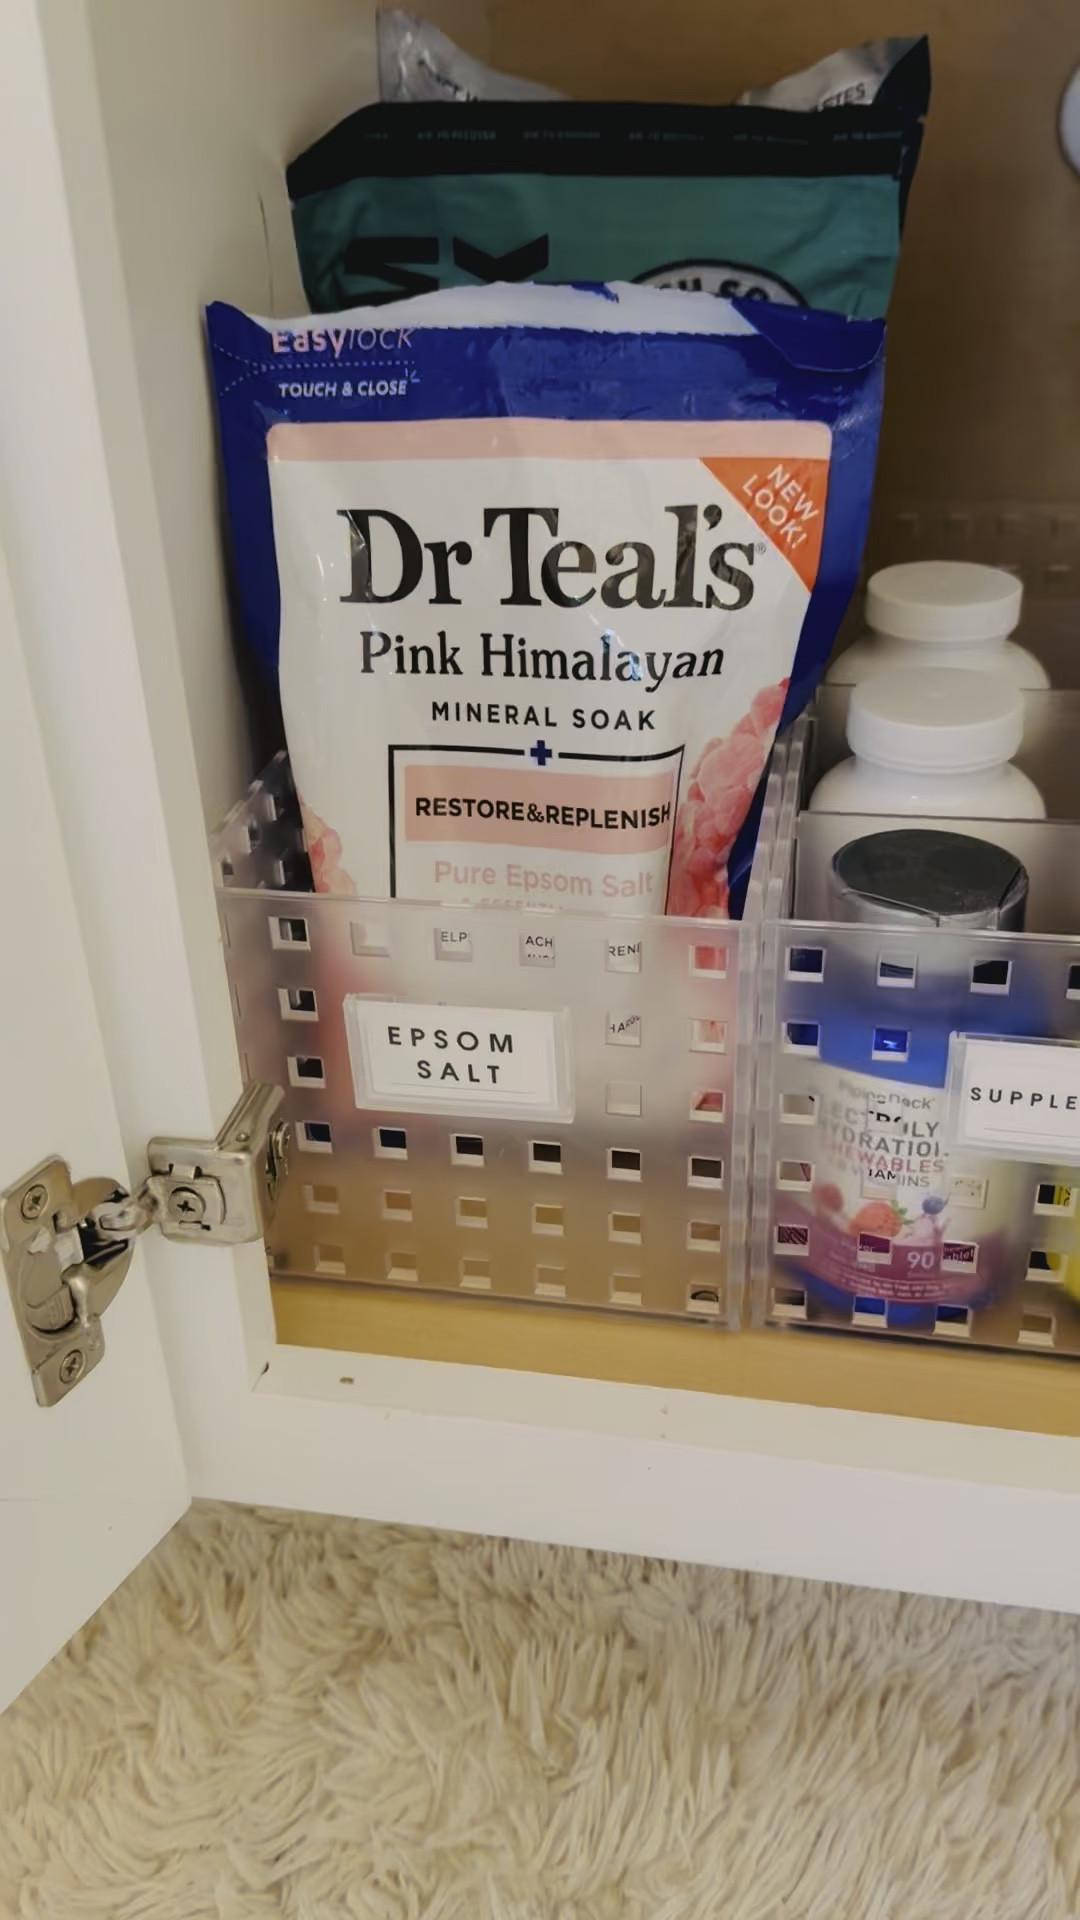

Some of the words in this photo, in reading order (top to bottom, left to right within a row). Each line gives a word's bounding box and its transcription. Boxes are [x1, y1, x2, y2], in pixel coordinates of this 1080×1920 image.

[279, 382, 337, 398] TOUCH
[342, 382, 353, 397] &
[358, 380, 407, 396] CLOSE
[767, 463, 819, 521] NEW
[742, 473, 807, 549] LOOK!
[336, 509, 472, 605] Dr
[483, 504, 755, 611] Teal's
[360, 630, 463, 676] Pink
[480, 630, 724, 693] Himalayan
[432, 701, 557, 727] MINERAL
[572, 708, 656, 731] SOAK
[434, 860, 497, 885] Pure
[506, 864, 592, 896] Epsom
[602, 872, 653, 897] Salt
[387, 1026, 513, 1053] EPSOM
[417, 1059, 500, 1083] SALT
[970, 1086, 1078, 1110] SUPPLE
[907, 1251, 934, 1269] 90
